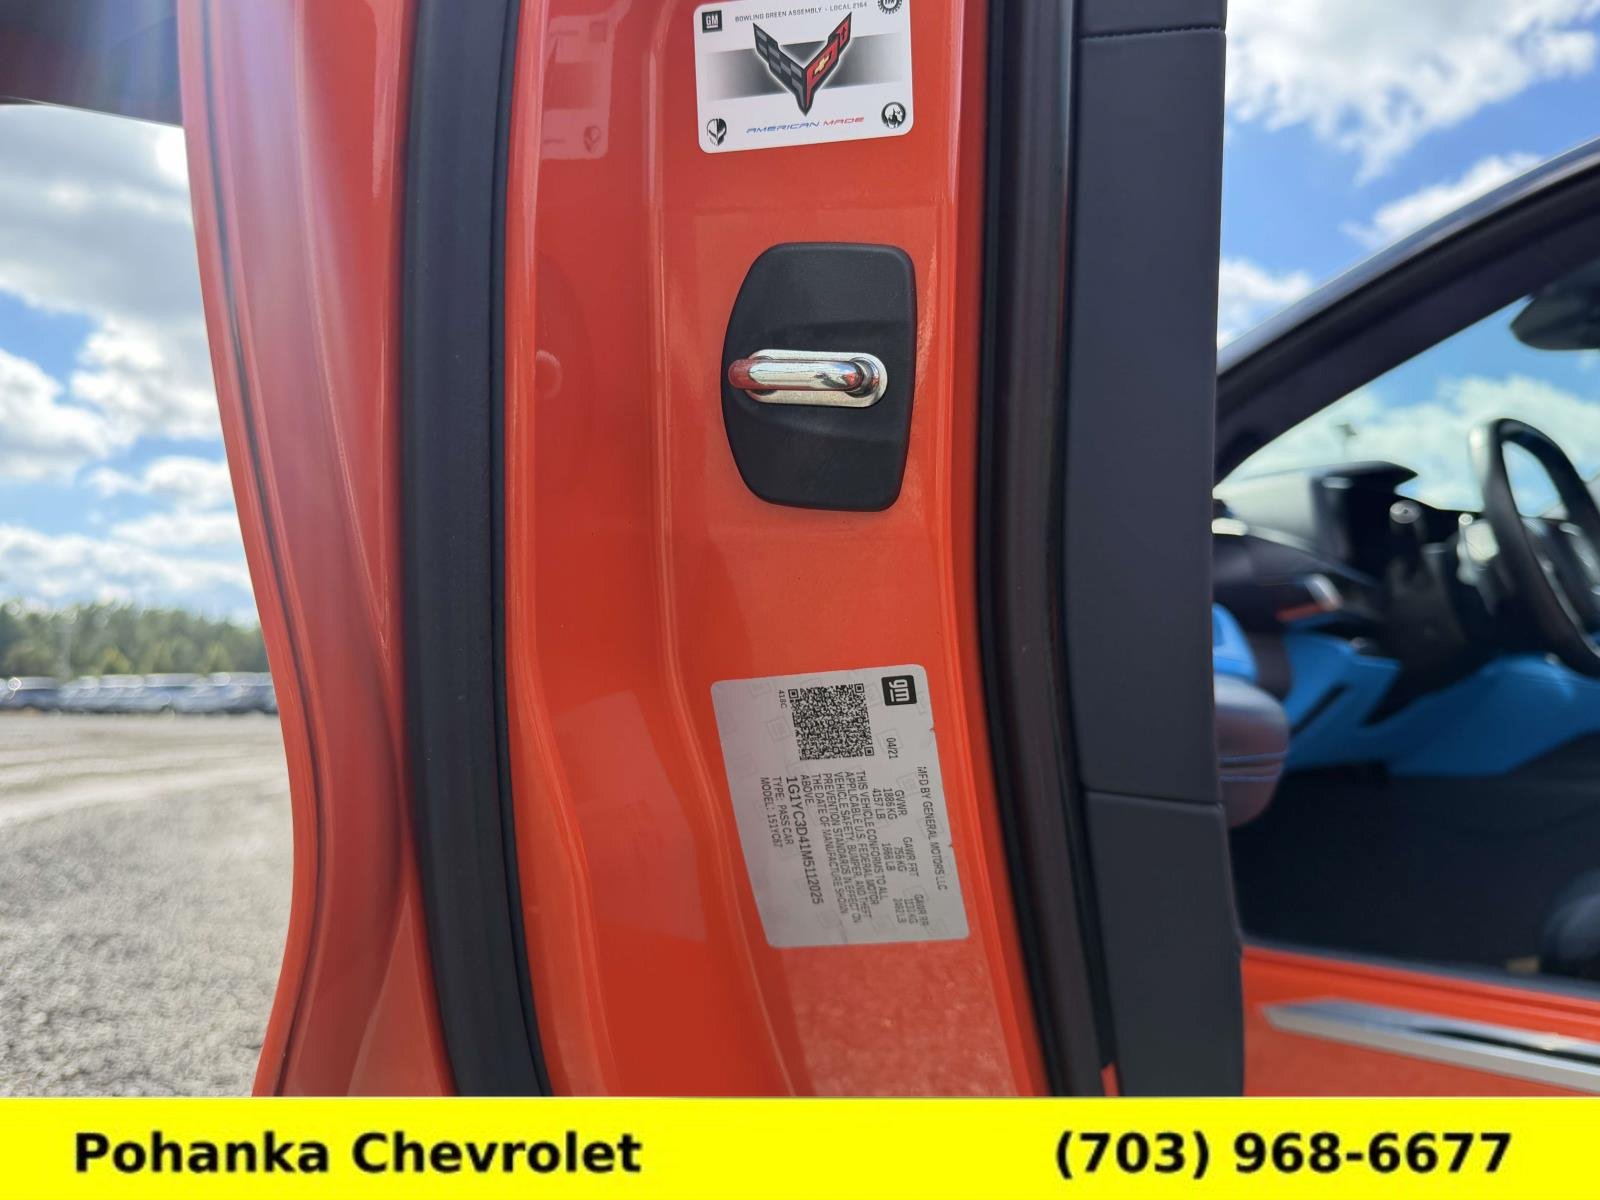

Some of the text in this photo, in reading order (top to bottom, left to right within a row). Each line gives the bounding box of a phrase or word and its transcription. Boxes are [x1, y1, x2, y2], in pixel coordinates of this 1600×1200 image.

[735, 13, 763, 22] BOWLING
[788, 8, 822, 16] ASSEMBLY
[830, 4, 850, 12] LOCAL
[746, 116, 864, 133] AMERICAN MADE
[887, 678, 910, 702] gm
[884, 736, 899, 759] 04/21
[810, 773, 823, 790] THE
[855, 770, 868, 789] THIS
[916, 766, 929, 785] MFD
[759, 776, 775, 810] MODEL:
[832, 771, 849, 808] VEHICLE
[893, 789, 908, 815] GVWR
[920, 787, 931, 799] BY
[771, 776, 794, 844] TYPE: PASS CAR
[814, 792, 828, 814] DATE
[858, 791, 874, 826] VEHICLE
[874, 808, 886, 819] LB
[886, 807, 897, 820] KG
[818, 815, 830, 827] OF
[821, 772, 841, 825] PREVENTION
[832, 827, 851, 874] STANDARDS
[843, 771, 863, 824] APPLICABLE
[857, 843, 873, 878] FEDERAL
[922, 800, 938, 840] GENERAL
[784, 775, 824, 904] 1G1YC3D41M5112025
[865, 828, 883, 872] CONFORMS
[902, 836, 916, 861] GAWR
[821, 828, 842, 886] MANUFACTURE
[929, 841, 944, 875] MOTORS
